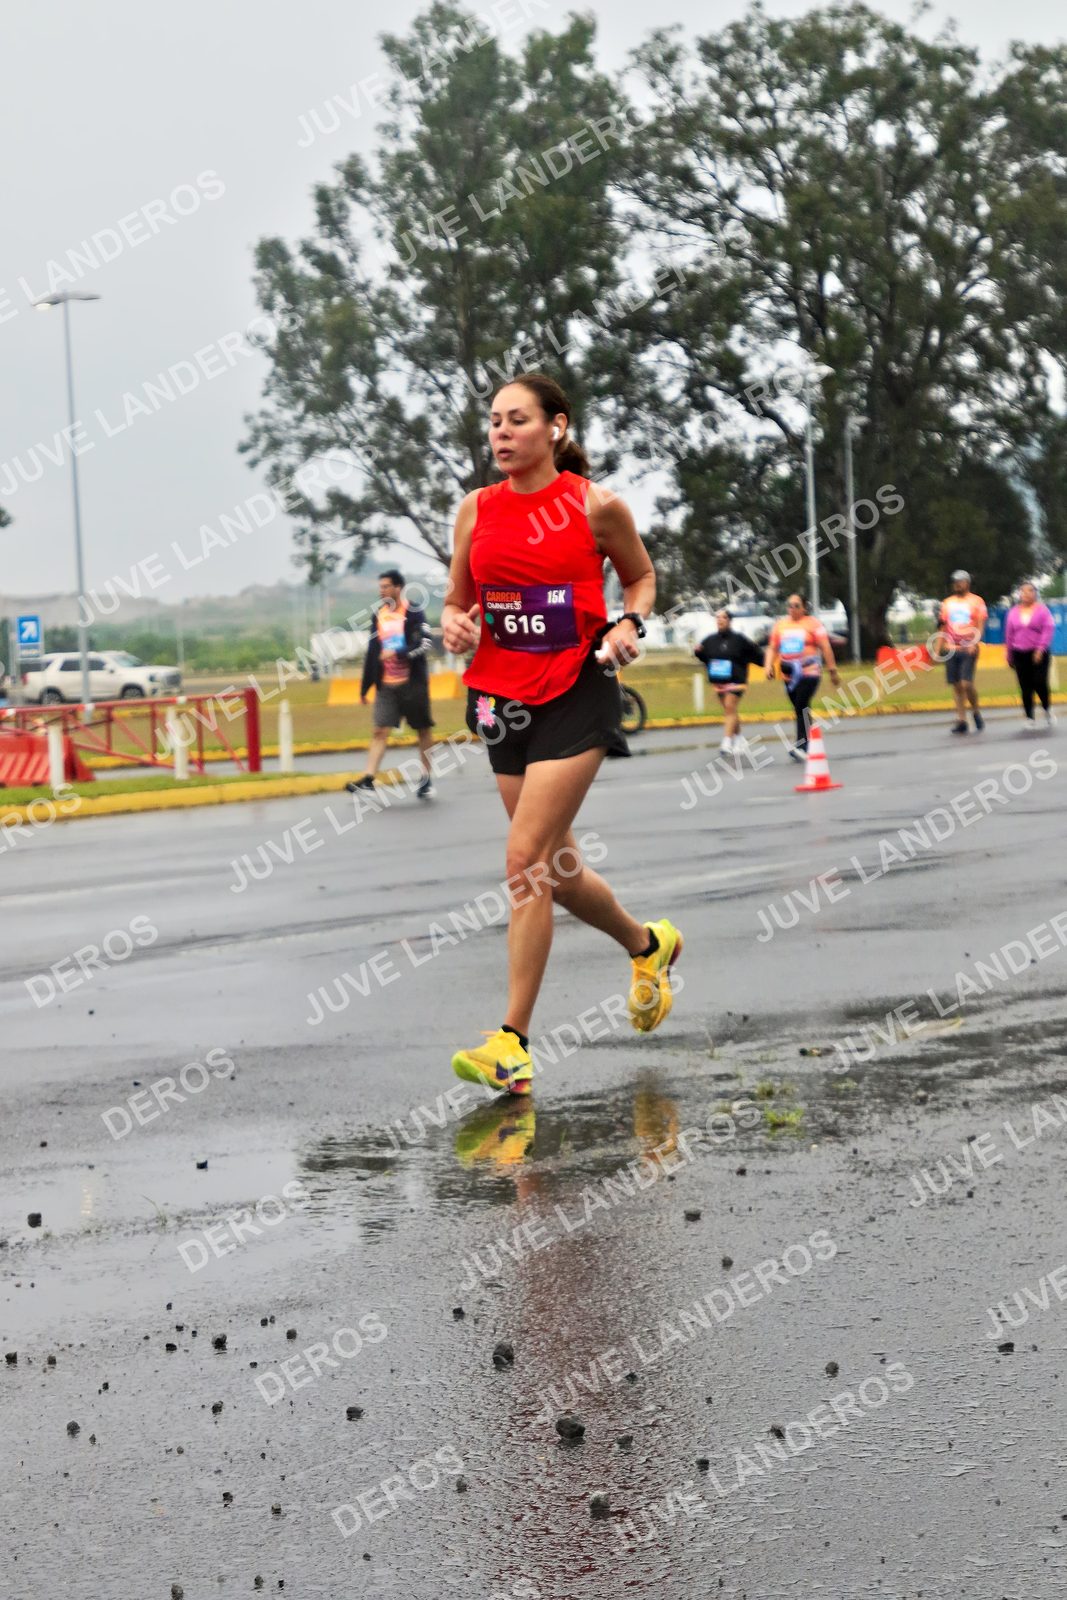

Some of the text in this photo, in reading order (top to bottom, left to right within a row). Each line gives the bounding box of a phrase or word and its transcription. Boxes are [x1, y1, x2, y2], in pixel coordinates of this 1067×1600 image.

[486, 591, 522, 602] CARRERA
[547, 589, 566, 604] 15K
[504, 614, 546, 634] 616
